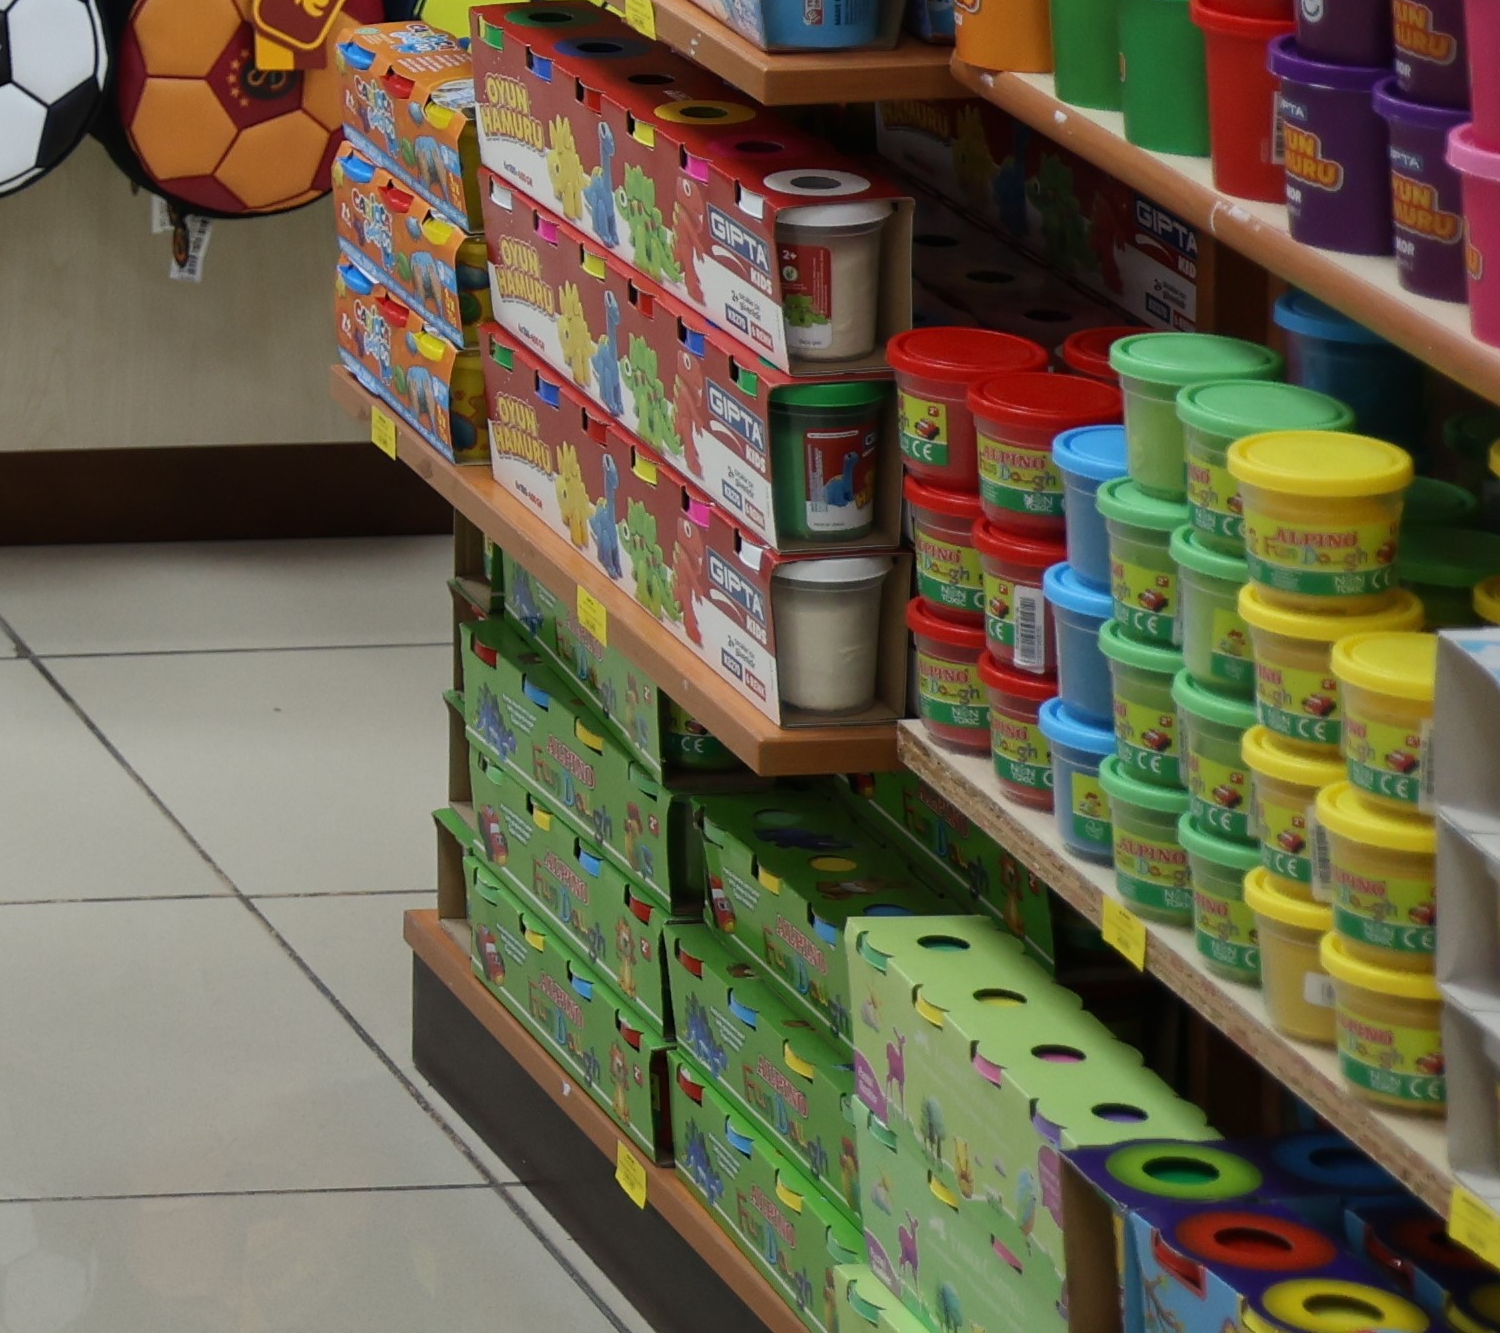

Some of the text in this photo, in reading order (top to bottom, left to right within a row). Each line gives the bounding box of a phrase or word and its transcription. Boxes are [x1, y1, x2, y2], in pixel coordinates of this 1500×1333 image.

[485, 74, 529, 109] OYUN
[481, 109, 545, 148] HAMURU
[500, 236, 540, 271] OYUN
[711, 210, 770, 272] GIPTA
[495, 267, 554, 315] HAMURU
[750, 267, 773, 296] KIDS
[496, 392, 538, 432] OYUN
[709, 387, 765, 450] GIPTA
[745, 443, 767, 474] KIDS
[982, 445, 1046, 471] ALPINO
[1276, 528, 1358, 547] ALPINO
[709, 554, 766, 620] GIPTA
[746, 613, 768, 646] KIDS
[547, 733, 596, 791] ALPINO
[543, 849, 589, 906] ALPINO
[775, 914, 828, 975] ALPINO
[756, 1055, 809, 1117] ALPINO
[749, 1183, 796, 1249] ALPINO
